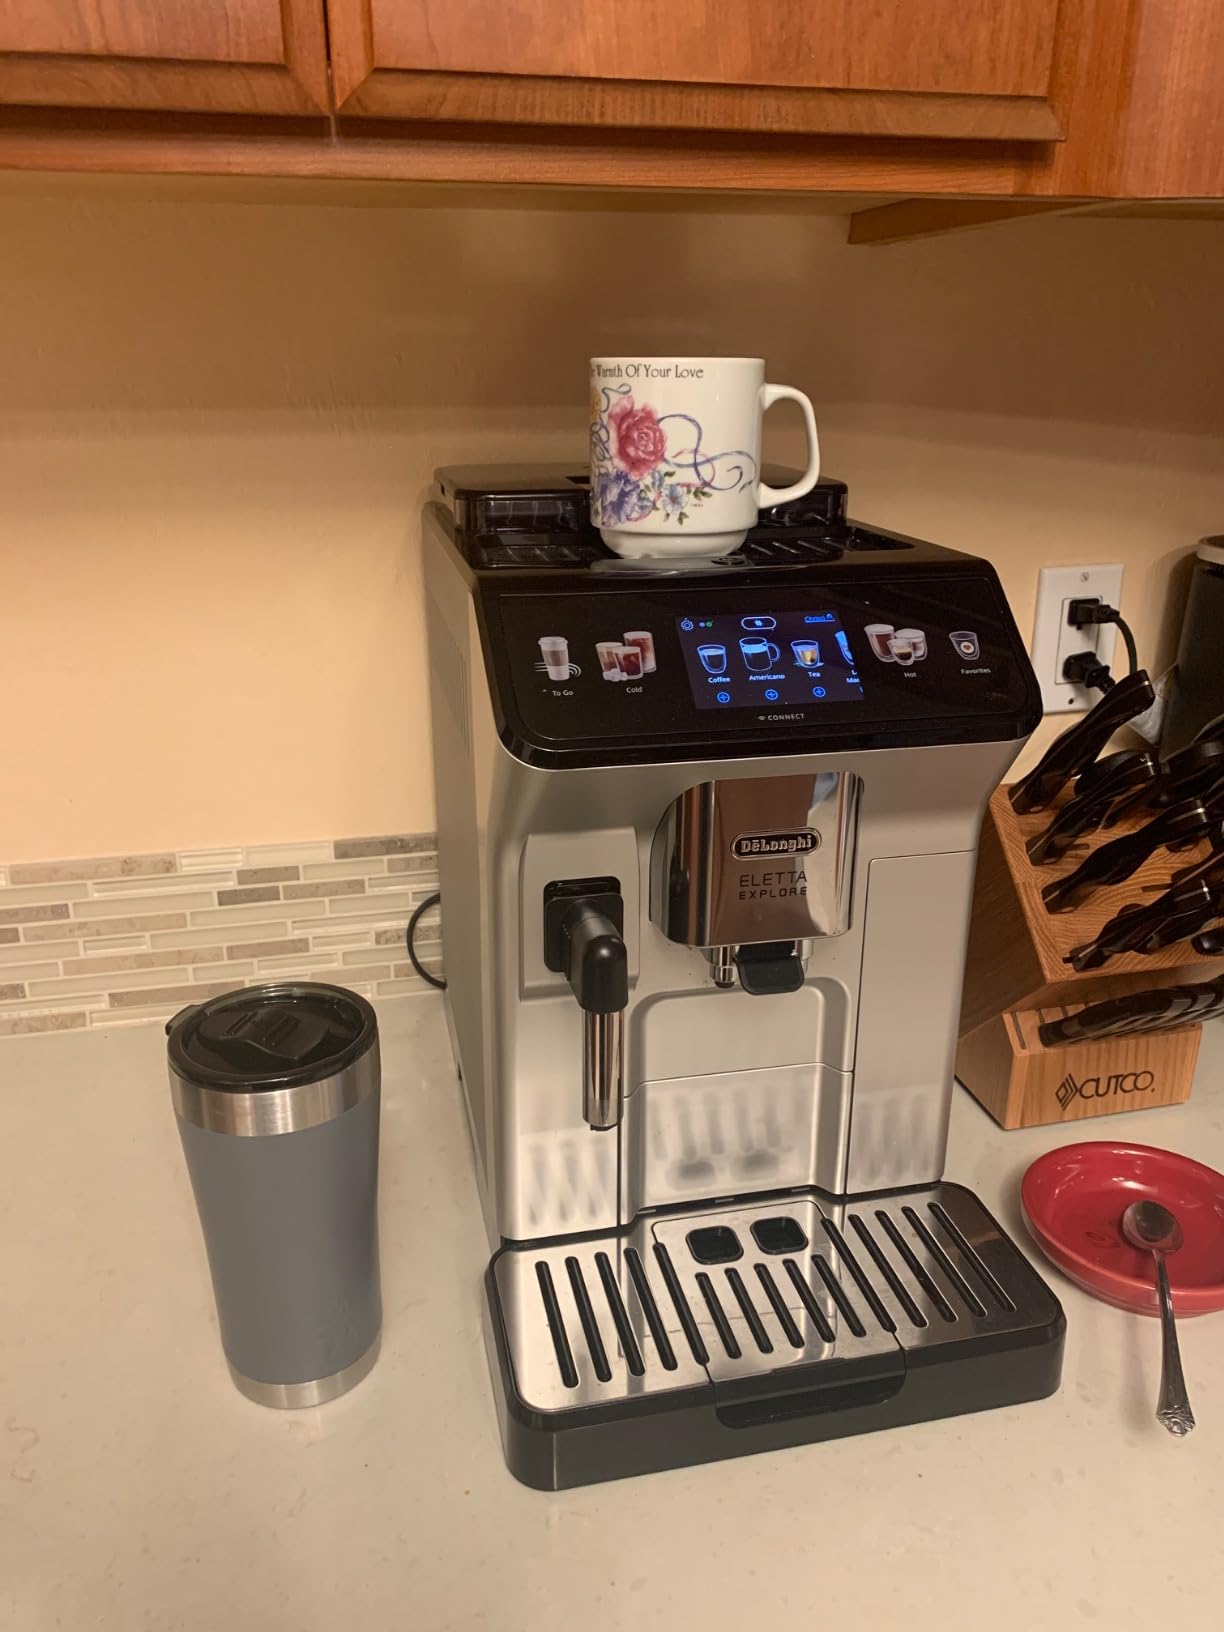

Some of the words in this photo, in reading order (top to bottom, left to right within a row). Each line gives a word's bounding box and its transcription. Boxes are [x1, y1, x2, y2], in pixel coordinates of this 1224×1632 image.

[625, 363, 641, 378] Of
[643, 363, 672, 378] Your
[675, 364, 704, 379] Love
[960, 667, 991, 675] Favorites
[708, 676, 731, 684] Coffee
[749, 674, 786, 682] Americano
[626, 686, 643, 694] Cold
[767, 713, 805, 721] CONNECT
[740, 870, 808, 888] ELETTA
[738, 886, 808, 900] EXPLORE
